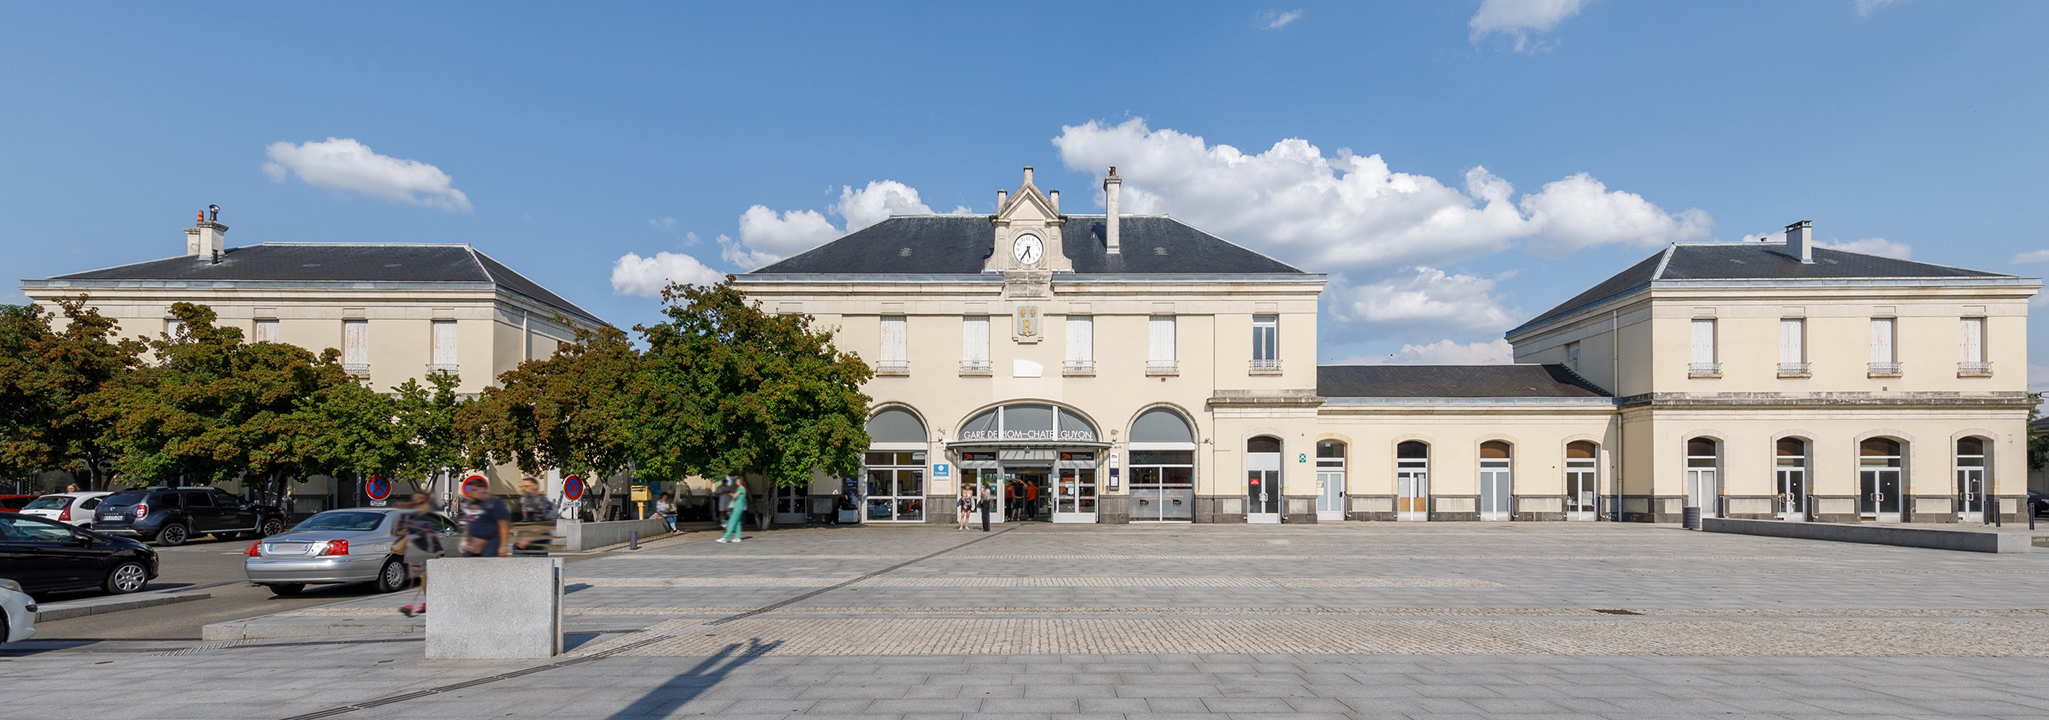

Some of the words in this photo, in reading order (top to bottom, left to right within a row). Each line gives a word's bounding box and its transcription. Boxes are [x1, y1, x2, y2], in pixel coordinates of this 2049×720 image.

[1023, 320, 1032, 333] R
[964, 430, 984, 439] GARE
[988, 430, 998, 438] DE
[1060, 430, 1092, 438] GUYON
